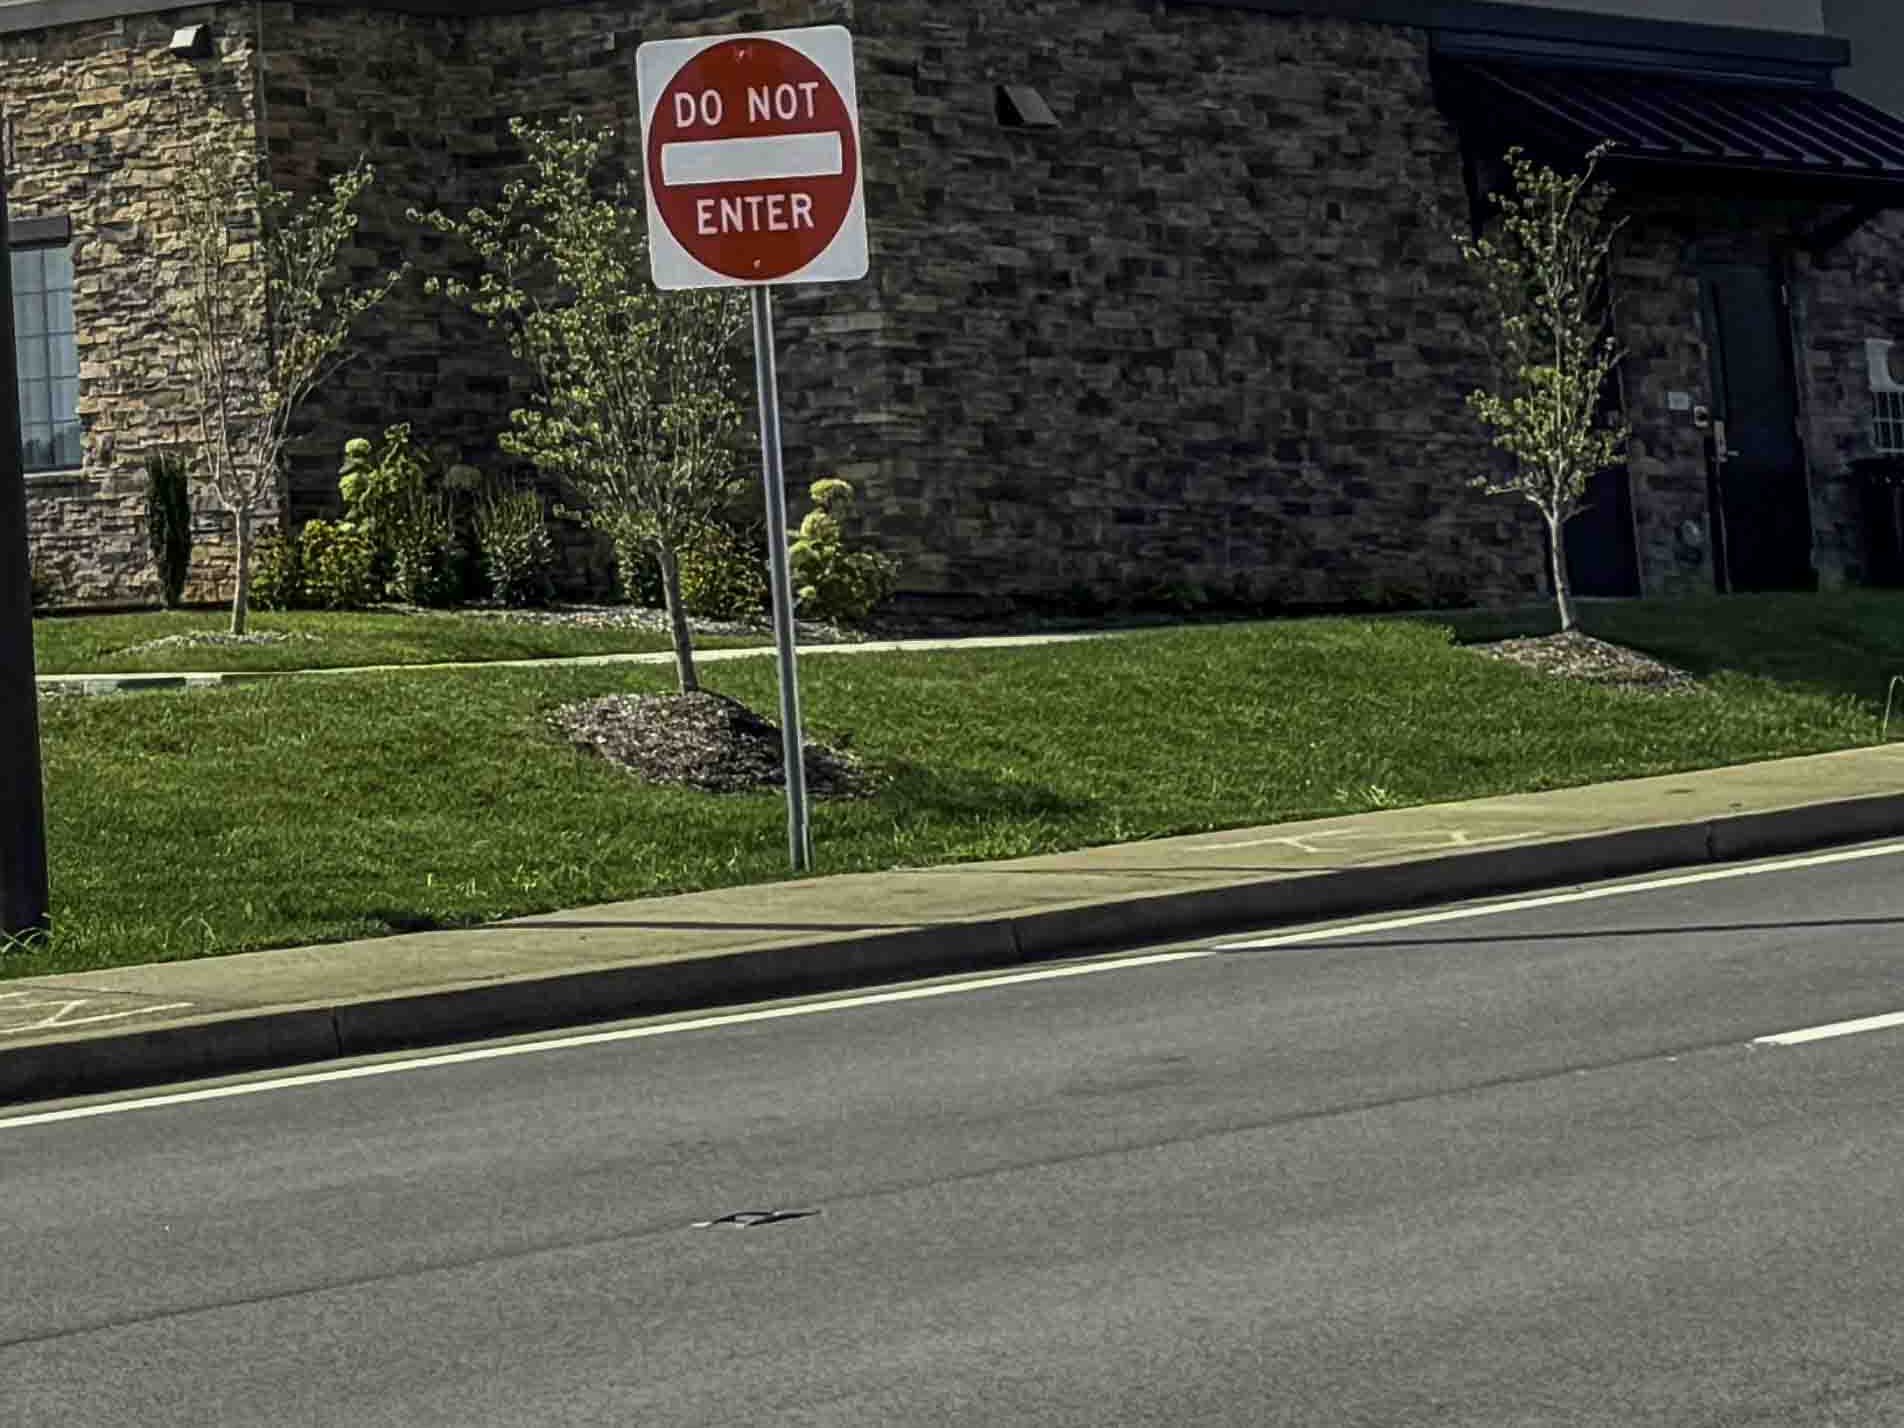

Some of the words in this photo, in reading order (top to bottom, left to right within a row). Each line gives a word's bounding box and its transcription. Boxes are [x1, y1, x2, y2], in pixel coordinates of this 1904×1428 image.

[674, 89, 723, 128] DO
[747, 82, 819, 123] NOT
[696, 194, 815, 235] ENTER
